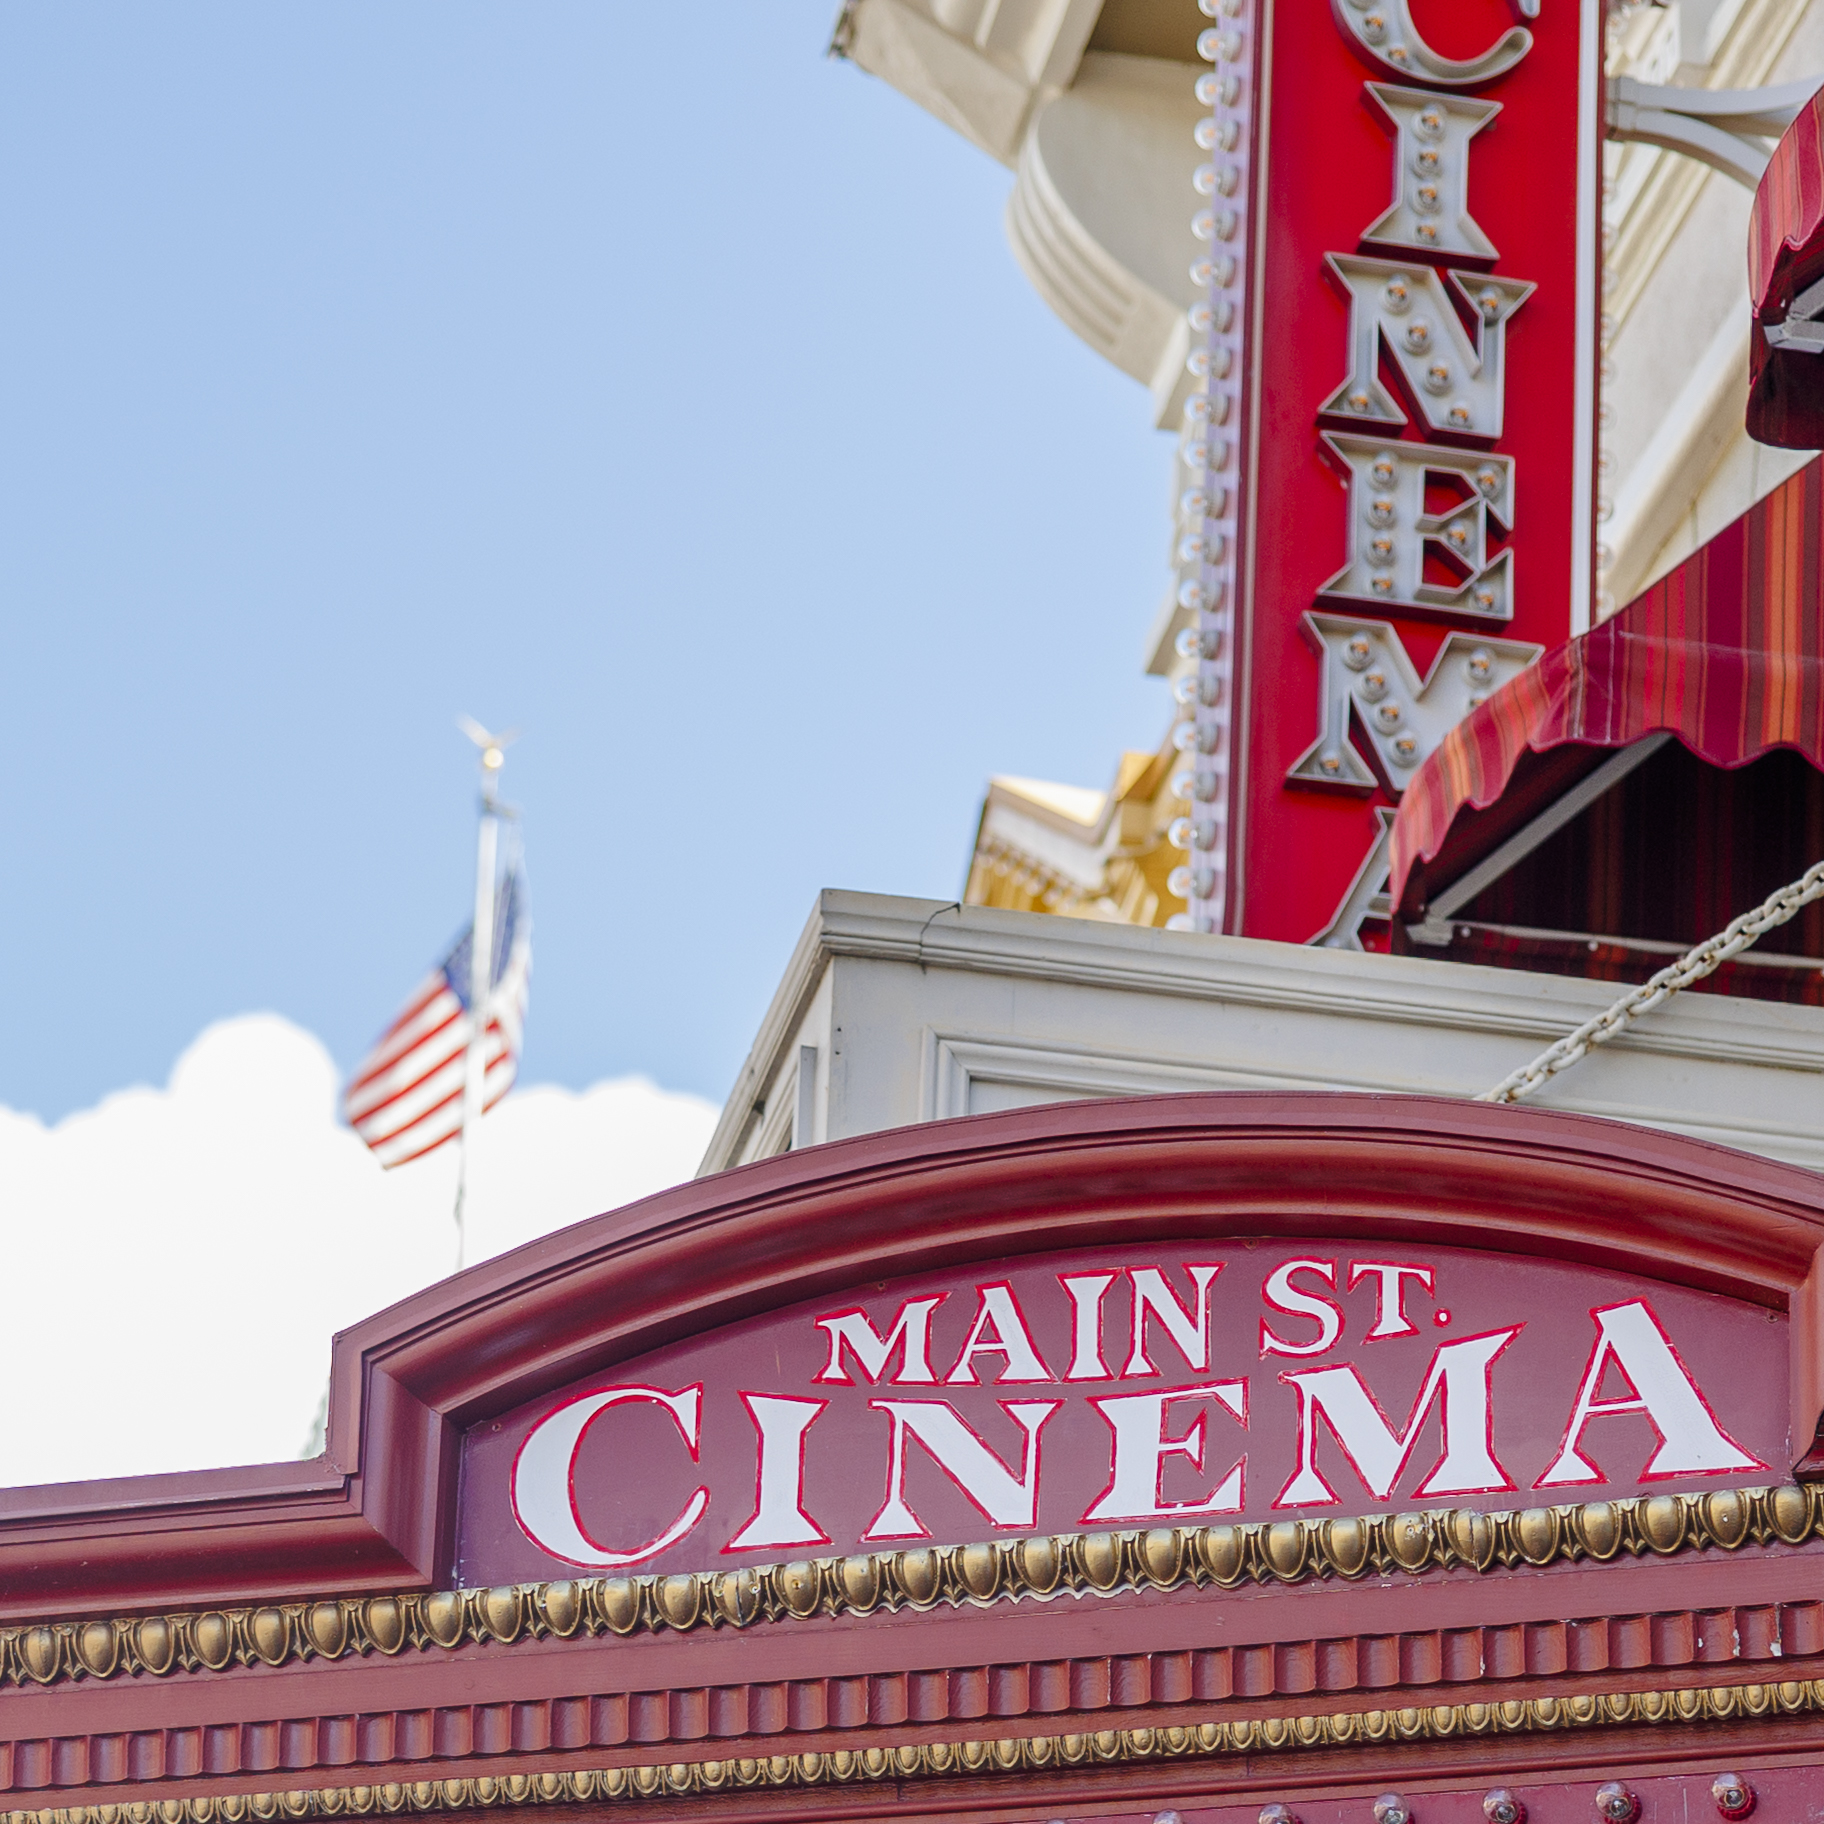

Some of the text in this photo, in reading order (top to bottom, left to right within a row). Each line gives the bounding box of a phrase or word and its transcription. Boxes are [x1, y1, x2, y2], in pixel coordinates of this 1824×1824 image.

[815, 1256, 1452, 1386] MAIN ST.
[511, 1298, 1771, 1568] CINEMA
